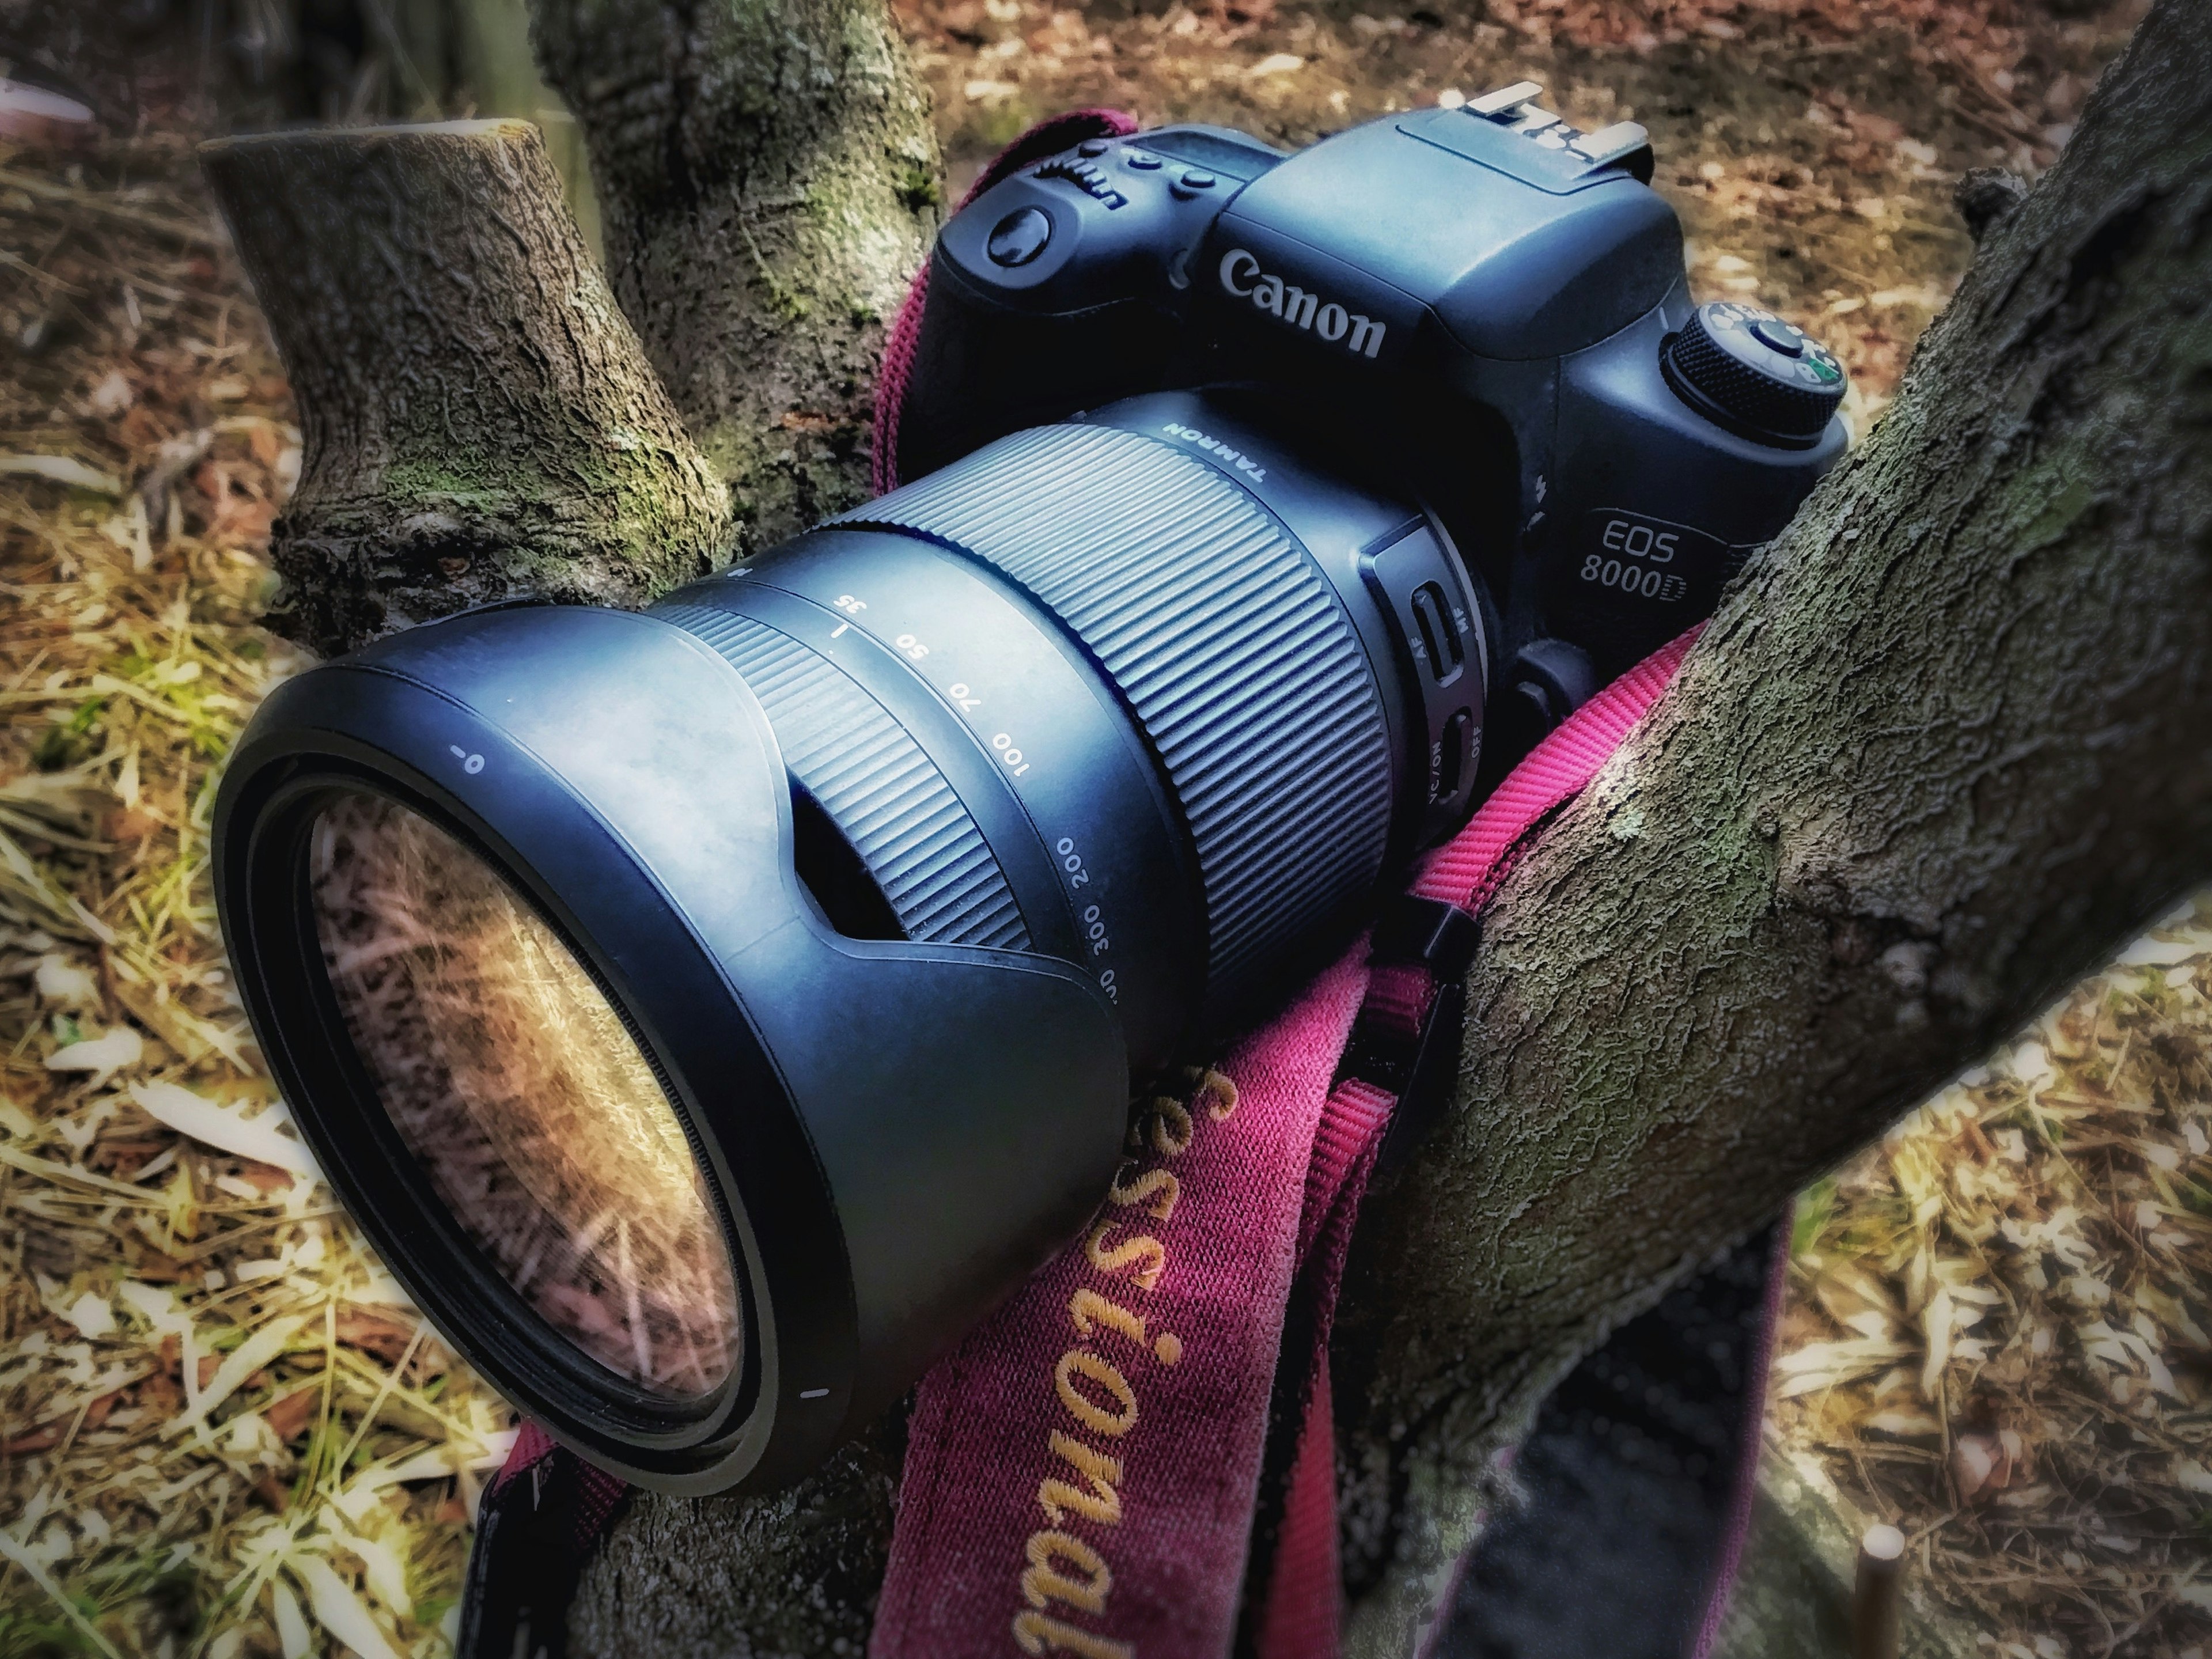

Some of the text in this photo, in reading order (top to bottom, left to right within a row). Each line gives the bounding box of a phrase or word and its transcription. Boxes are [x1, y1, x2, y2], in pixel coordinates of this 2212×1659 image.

[1219, 248, 1387, 358] Canon
[1162, 422, 1267, 483] TAMRON
[1603, 520, 1679, 563] EOS
[1580, 554, 1687, 601] 8000D
[833, 594, 868, 614] 35
[1453, 607, 1469, 634] MF
[896, 634, 930, 660] 50
[1410, 637, 1427, 659] AF
[949, 683, 982, 713] 70
[992, 733, 1030, 777] 100
[1471, 726, 1482, 759] OFF
[1056, 837, 1089, 889] 200
[1084, 905, 1109, 956] 300
[1100, 969, 1118, 1005] 00
